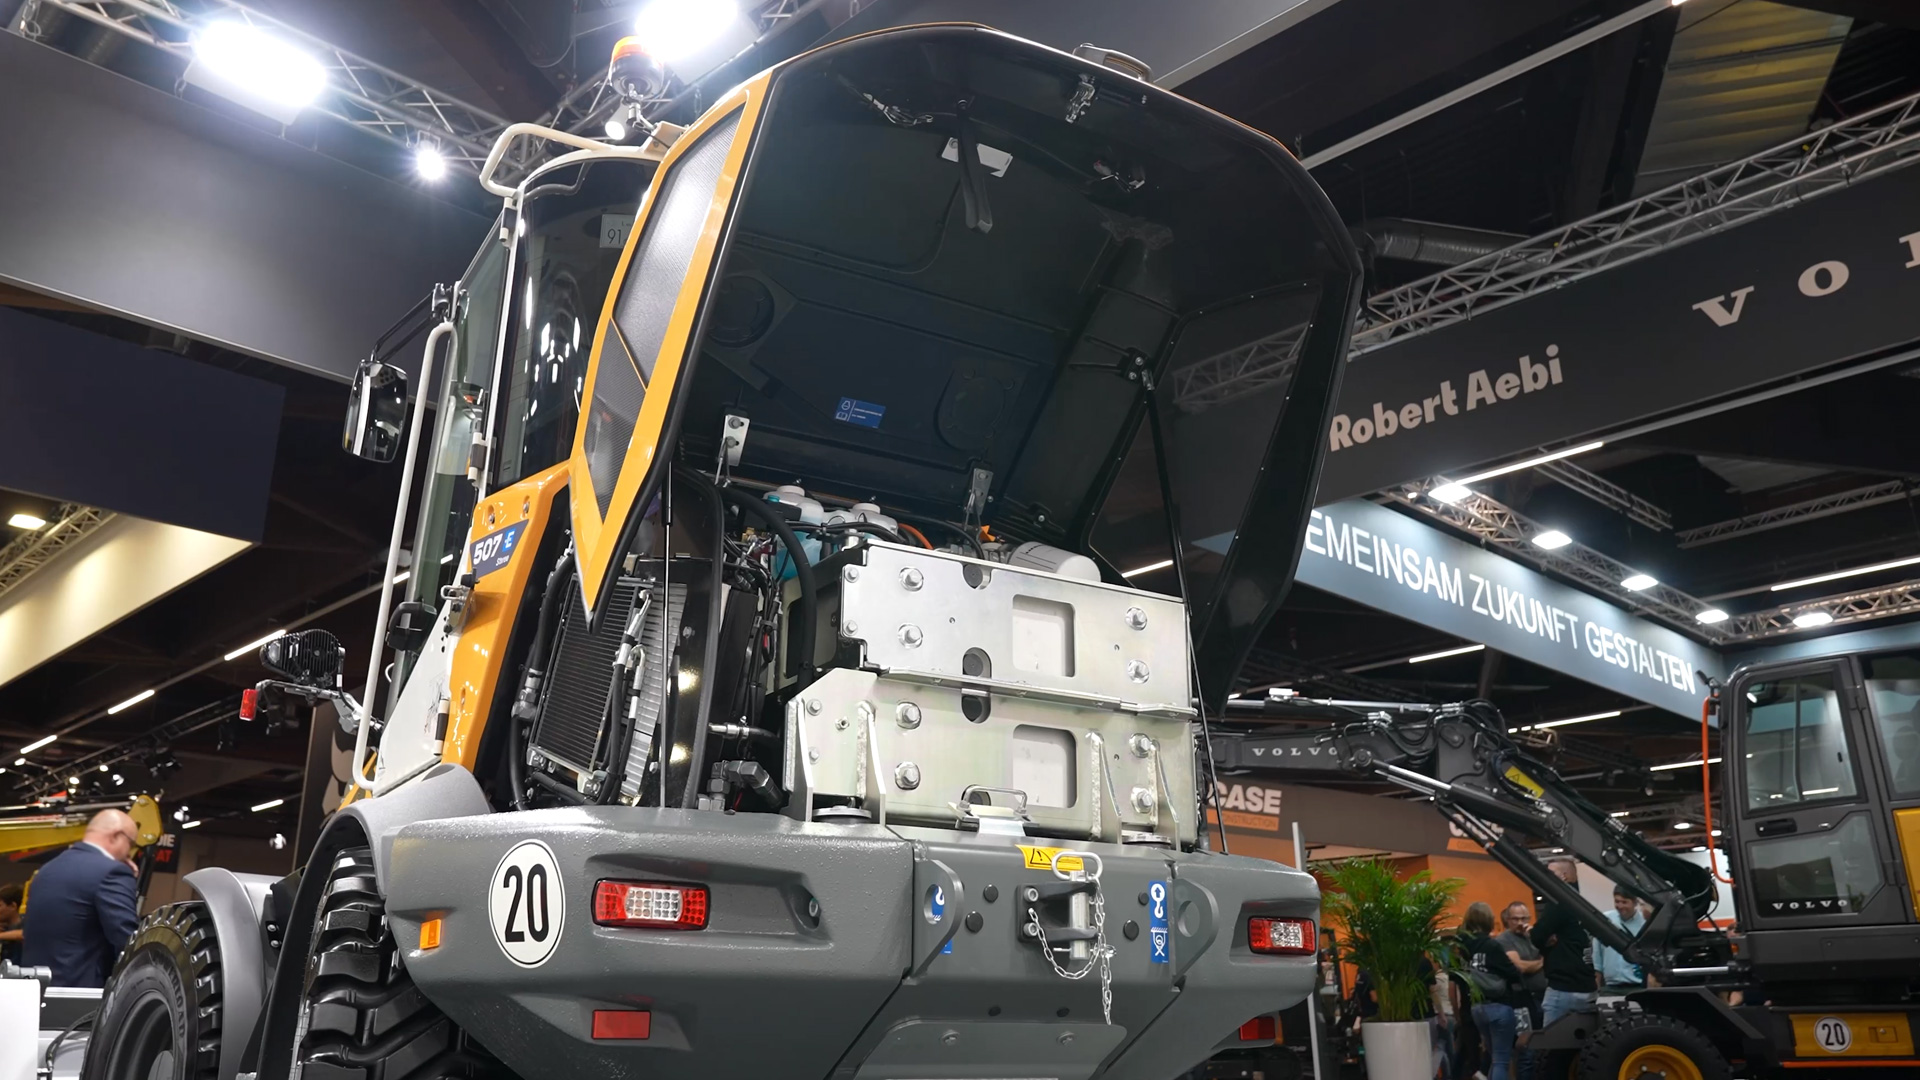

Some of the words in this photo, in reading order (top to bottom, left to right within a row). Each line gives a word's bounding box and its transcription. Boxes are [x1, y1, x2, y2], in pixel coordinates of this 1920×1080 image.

[1329, 380, 1459, 452] Robert
[1465, 344, 1563, 411] Aebi
[473, 533, 503, 565] 507
[1305, 509, 1464, 607] EMEINSAM
[1469, 573, 1578, 650] ZUKUNFT
[1585, 621, 1696, 695] GESTALTEN
[1252, 747, 1338, 757] VOLVO
[1207, 781, 1282, 815] CASE
[503, 863, 549, 943] 20
[1772, 899, 1848, 910] VOLVO
[1822, 1022, 1846, 1046] 20
